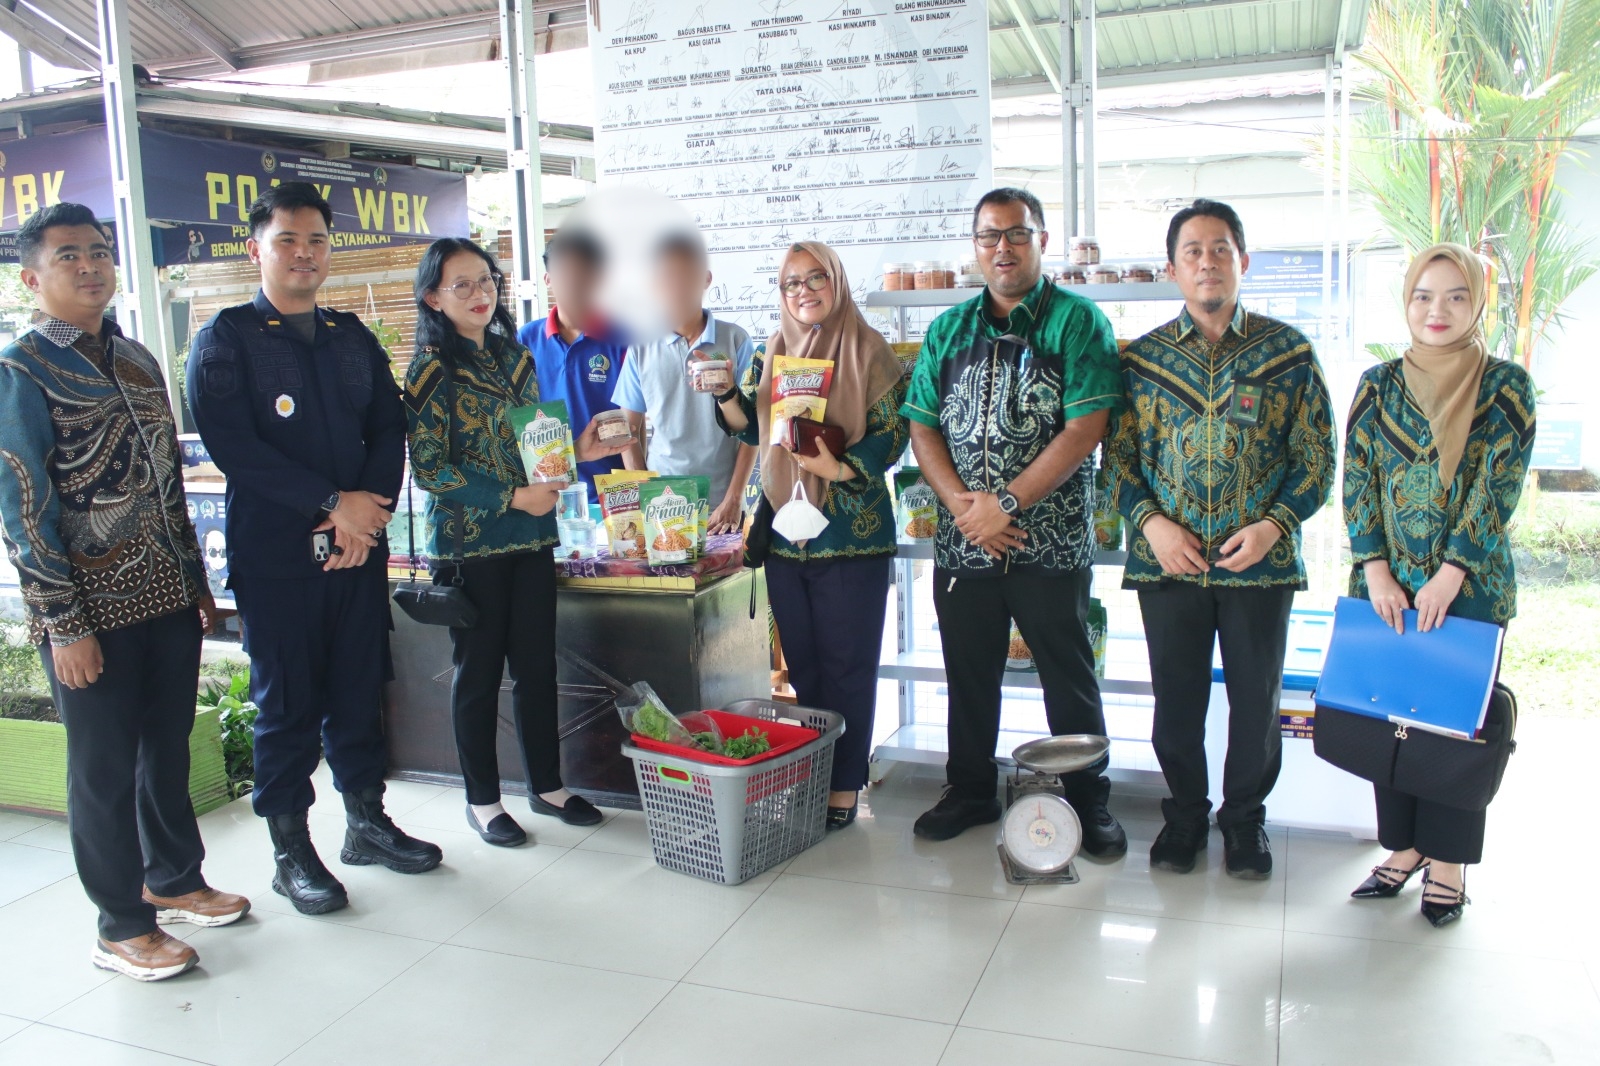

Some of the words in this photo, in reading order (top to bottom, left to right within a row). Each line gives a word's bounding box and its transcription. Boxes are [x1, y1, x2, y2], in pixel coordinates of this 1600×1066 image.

[895, 2, 915, 11] GILANG
[842, 8, 862, 17] RIYADI
[910, 14, 925, 22] KASI
[926, 11, 951, 21] BINADIK
[751, 18, 770, 27] HUTAN
[771, 15, 803, 25] TRIWIBOWO
[843, 19, 876, 30] MINKAMTIB
[678, 27, 696, 37] BAGUS
[697, 25, 714, 35] PARAS
[715, 23, 731, 32] ETIKA
[758, 29, 789, 39] KASUBBAG
[612, 37, 624, 45] DERI
[625, 33, 658, 43] PRIHANDOKO
[688, 40, 701, 48] KASI
[702, 38, 721, 46] GIATJA
[633, 47, 647, 55] KPLP
[884, 50, 918, 60] ISNANDAR
[933, 45, 968, 55] NOVERIANDA
[827, 57, 847, 66] CANDRA
[741, 65, 771, 75] SURATNO
[756, 88, 774, 96] TATA
[777, 86, 802, 94] USAHA
[824, 125, 871, 136] MINKAMTIB
[686, 139, 715, 149] GIATJA
[772, 163, 793, 172] KPLP
[766, 194, 801, 204] BINADIK
[352, 186, 431, 235] WBK
[538, 419, 558, 433] Akar
[521, 423, 569, 452] Pinang
[661, 497, 683, 509] Akar
[645, 502, 695, 523] Pinang
